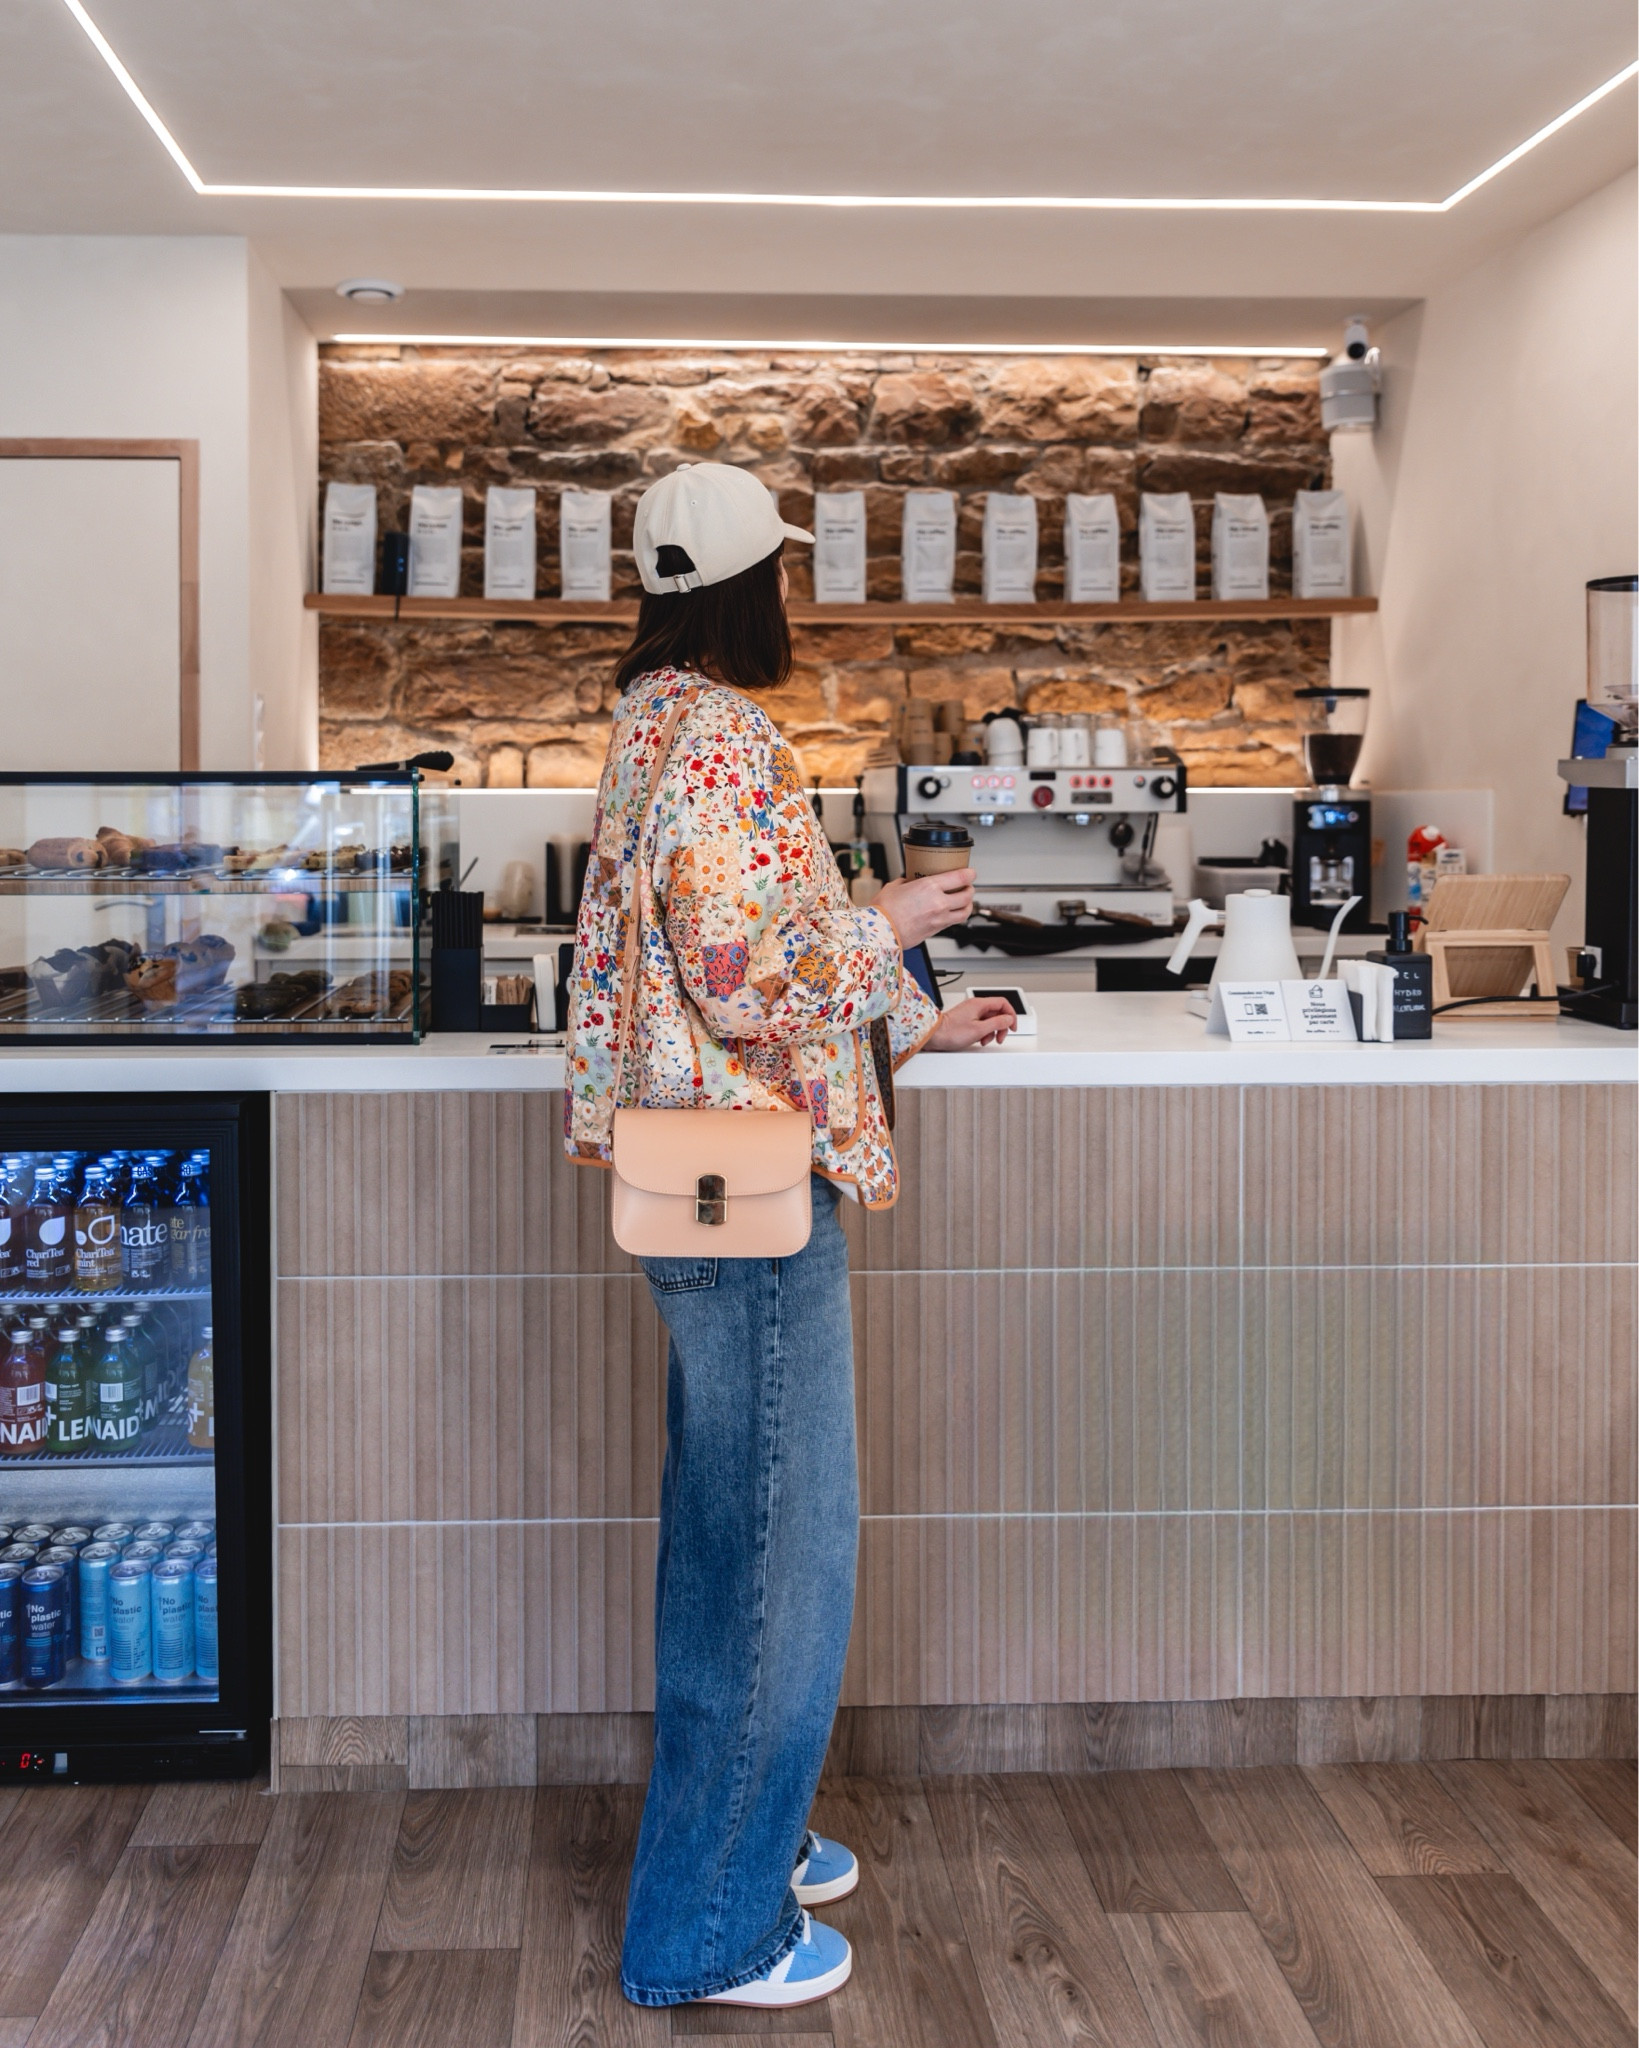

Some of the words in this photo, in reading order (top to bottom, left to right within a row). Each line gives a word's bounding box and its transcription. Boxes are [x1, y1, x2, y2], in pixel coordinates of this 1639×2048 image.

[26, 1247, 64, 1260] ChariTea
[76, 1247, 114, 1259] ChariTea
[26, 1260, 39, 1268] red
[162, 1597, 176, 1606] No
[31, 1604, 45, 1613] No
[113, 1606, 142, 1615] plastic
[162, 1602, 191, 1615] plastic
[31, 1609, 62, 1624] plastic
[31, 1621, 55, 1631] water
